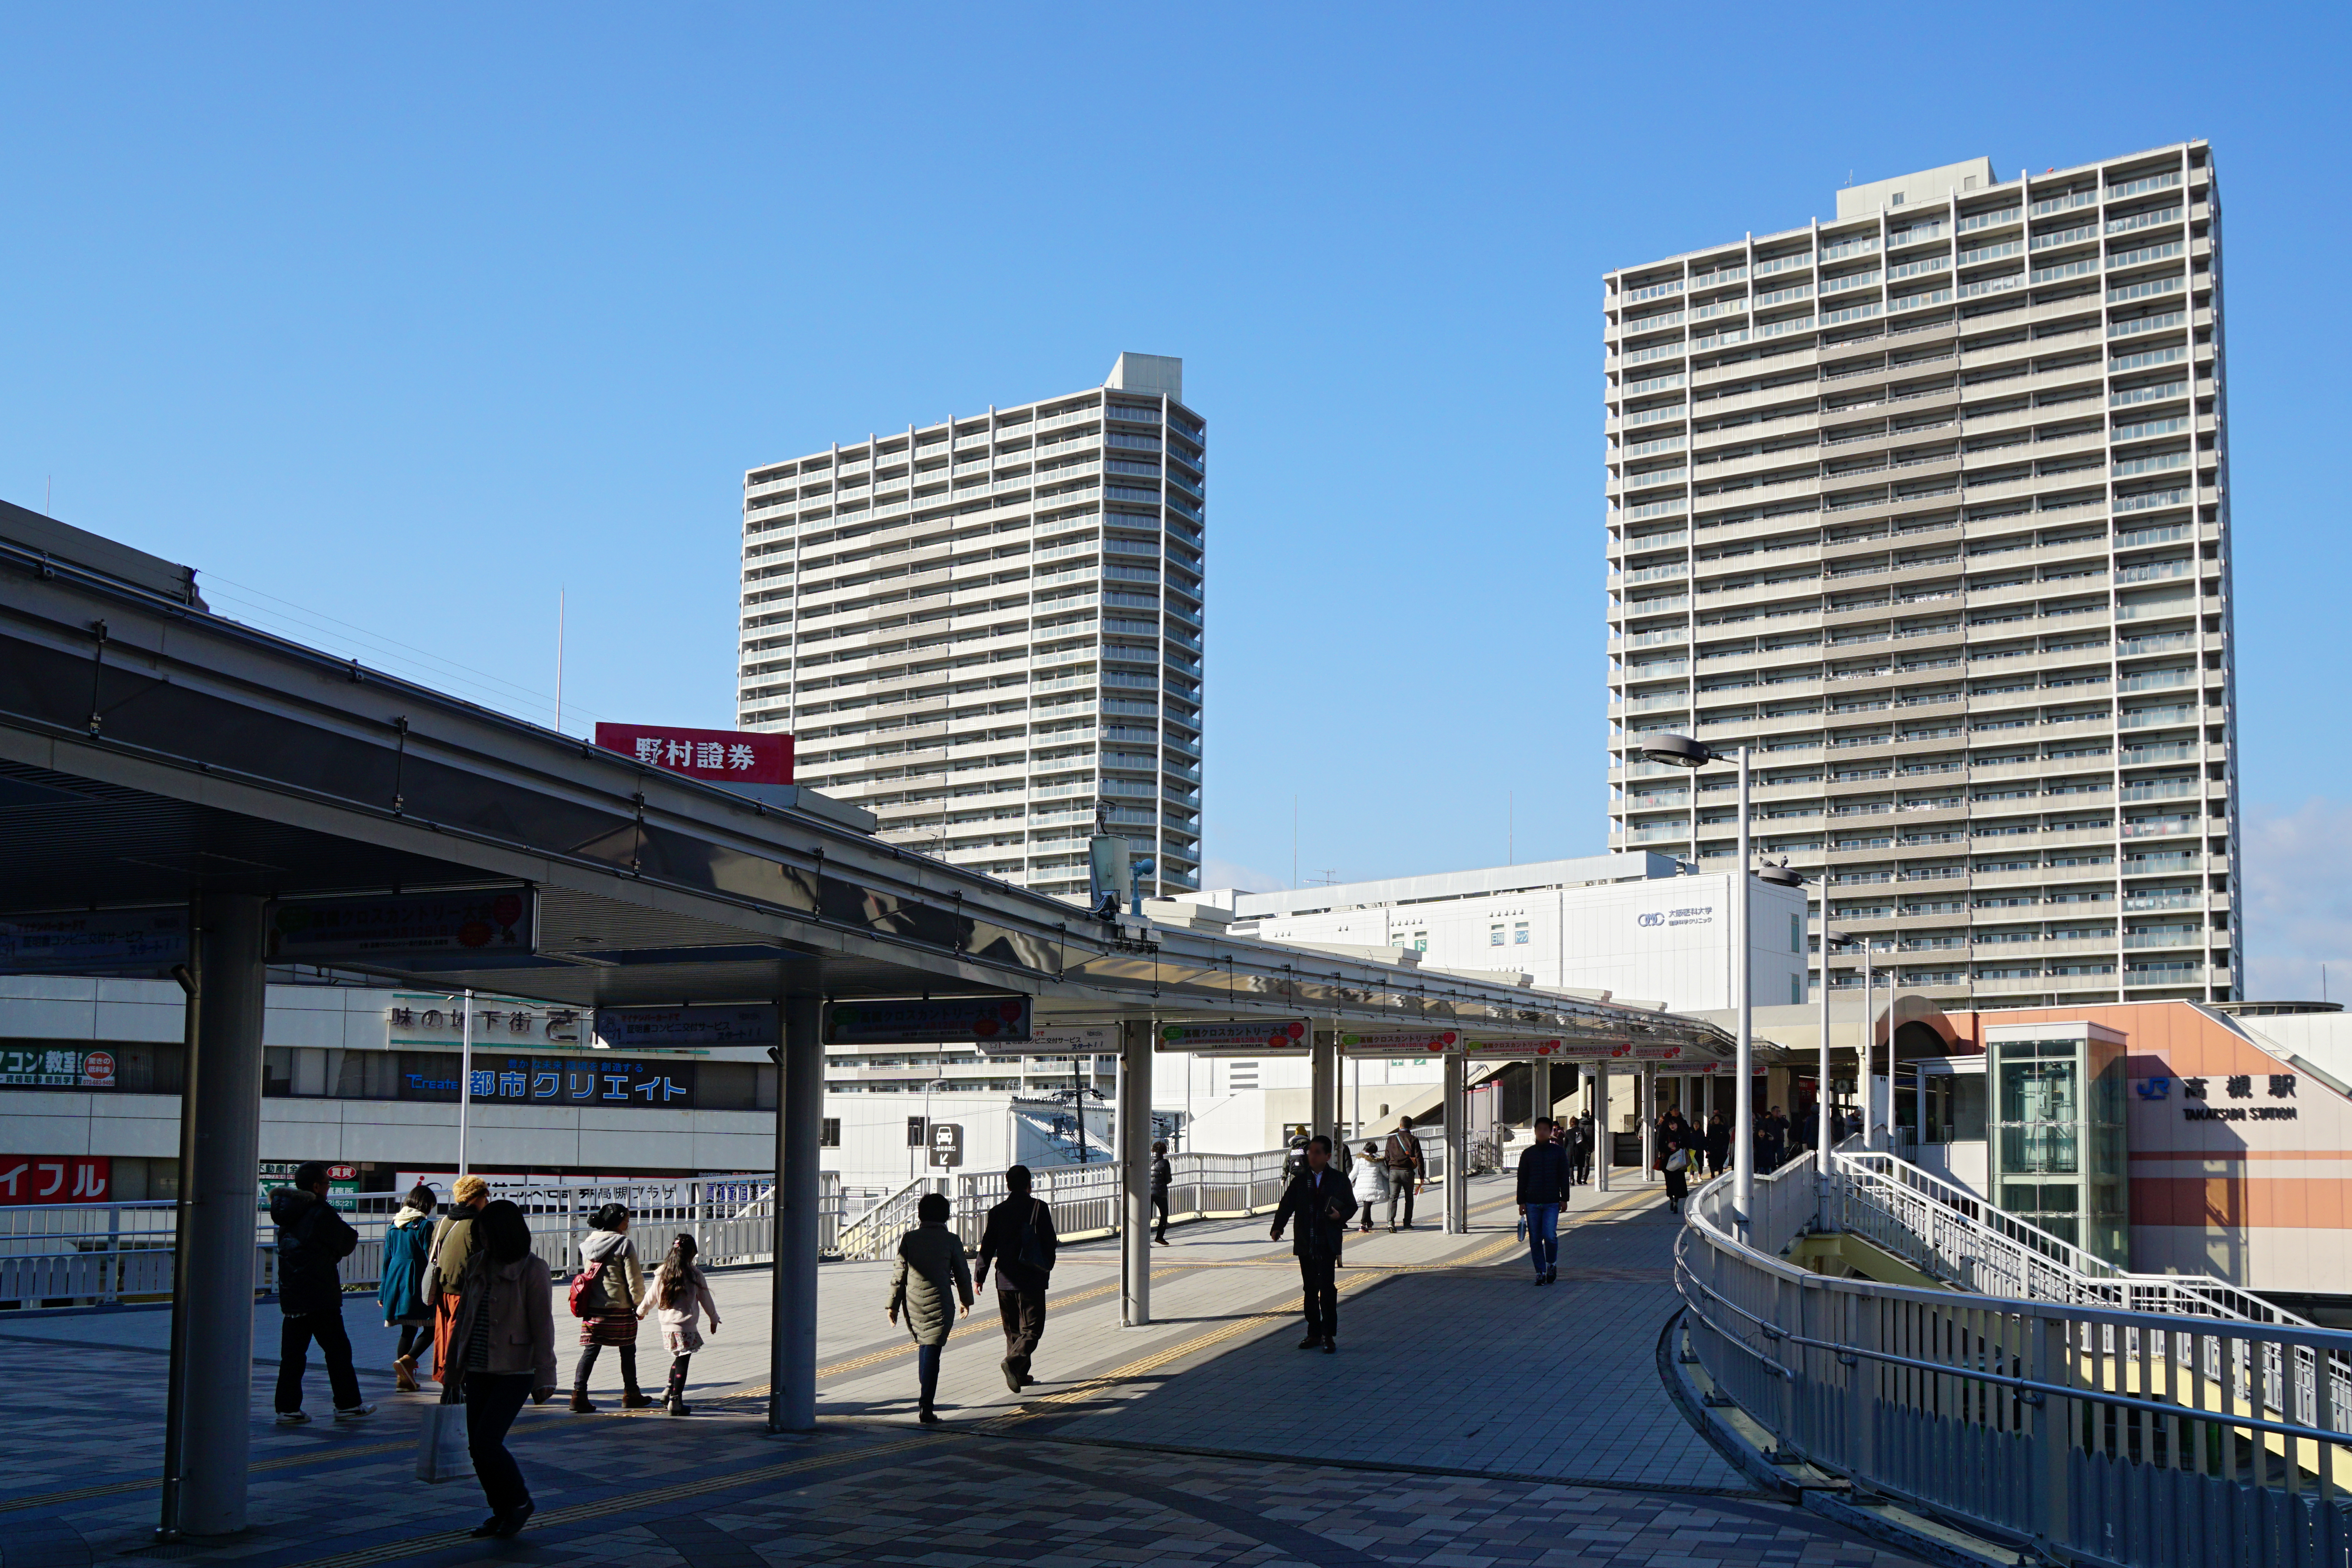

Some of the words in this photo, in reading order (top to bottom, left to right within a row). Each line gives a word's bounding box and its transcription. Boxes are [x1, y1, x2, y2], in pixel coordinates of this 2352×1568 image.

[635, 737, 755, 771] 野村證券
[1668, 906, 1713, 918] 大阪医科大学
[1492, 933, 1504, 944] 日帰
[1516, 931, 1528, 942] ドック
[392, 1007, 531, 1034] 味の地下街
[627, 1021, 730, 1034] 証明書コンビニ交付サービス
[1183, 1026, 1288, 1038] 高槻クロスカントリー大会
[1360, 1034, 1444, 1044] 高槻クロスカントリー大会
[88, 1065, 111, 1074] 低料金
[470, 1071, 686, 1101] 都市クリエイト
[2137, 1077, 2170, 1095] JR
[2183, 1074, 2297, 1100] 高槻駅
[2183, 1107, 2247, 1122] TAKATSUKI
[2249, 1106, 2298, 1121] STATION
[331, 1167, 353, 1177] 賃貸
[0, 1163, 105, 1197] イフル
